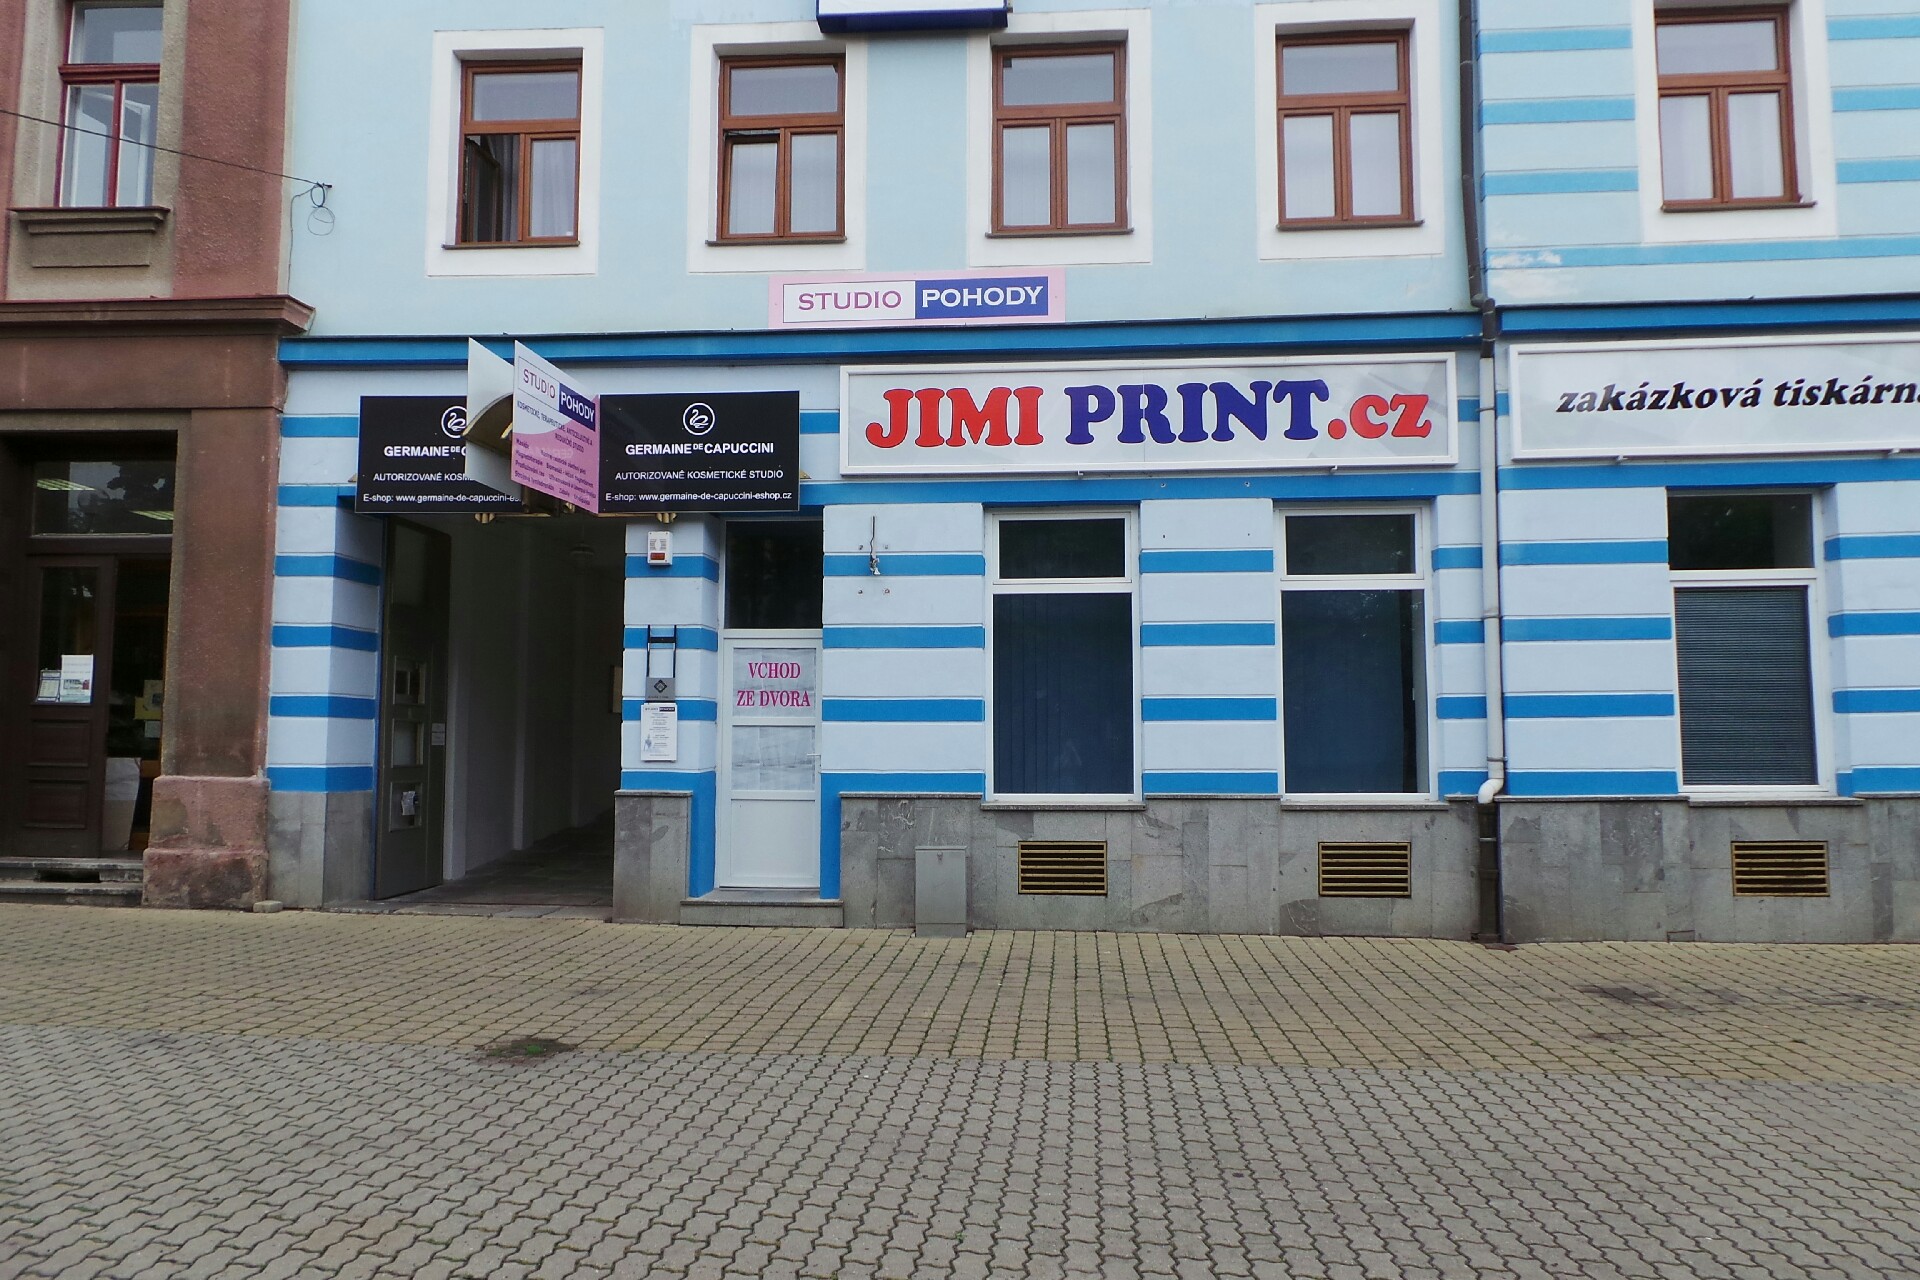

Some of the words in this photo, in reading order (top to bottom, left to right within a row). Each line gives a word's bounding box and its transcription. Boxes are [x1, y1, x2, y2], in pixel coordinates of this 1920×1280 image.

[798, 290, 902, 311] STUDIO
[921, 286, 1044, 308] POHODY
[523, 369, 556, 399] STUDIO
[560, 391, 595, 423] POHODY
[1556, 378, 1764, 413] zakázková
[865, 386, 1044, 448] JIMI
[1063, 379, 1433, 445] PRINT.cz
[383, 445, 450, 457] GERMAINE
[450, 445, 461, 453] DE
[625, 443, 692, 455] GERMAINE
[692, 442, 704, 451] DE
[704, 442, 774, 454] CAPUCCINI
[373, 471, 442, 481] AUTORIZOVANÉ
[615, 469, 685, 481] AUTORIZOVANÉ
[687, 469, 747, 480] KOSMETICKÉ
[749, 469, 784, 479] STUDIO
[363, 493, 393, 503] E-shop:
[605, 492, 636, 502] E-shop:
[638, 491, 792, 502] www.germaine-de-capuccini-eshop.cz
[747, 662, 801, 679] VCHOD
[736, 690, 755, 706] ZE
[759, 690, 811, 707] DVORA
